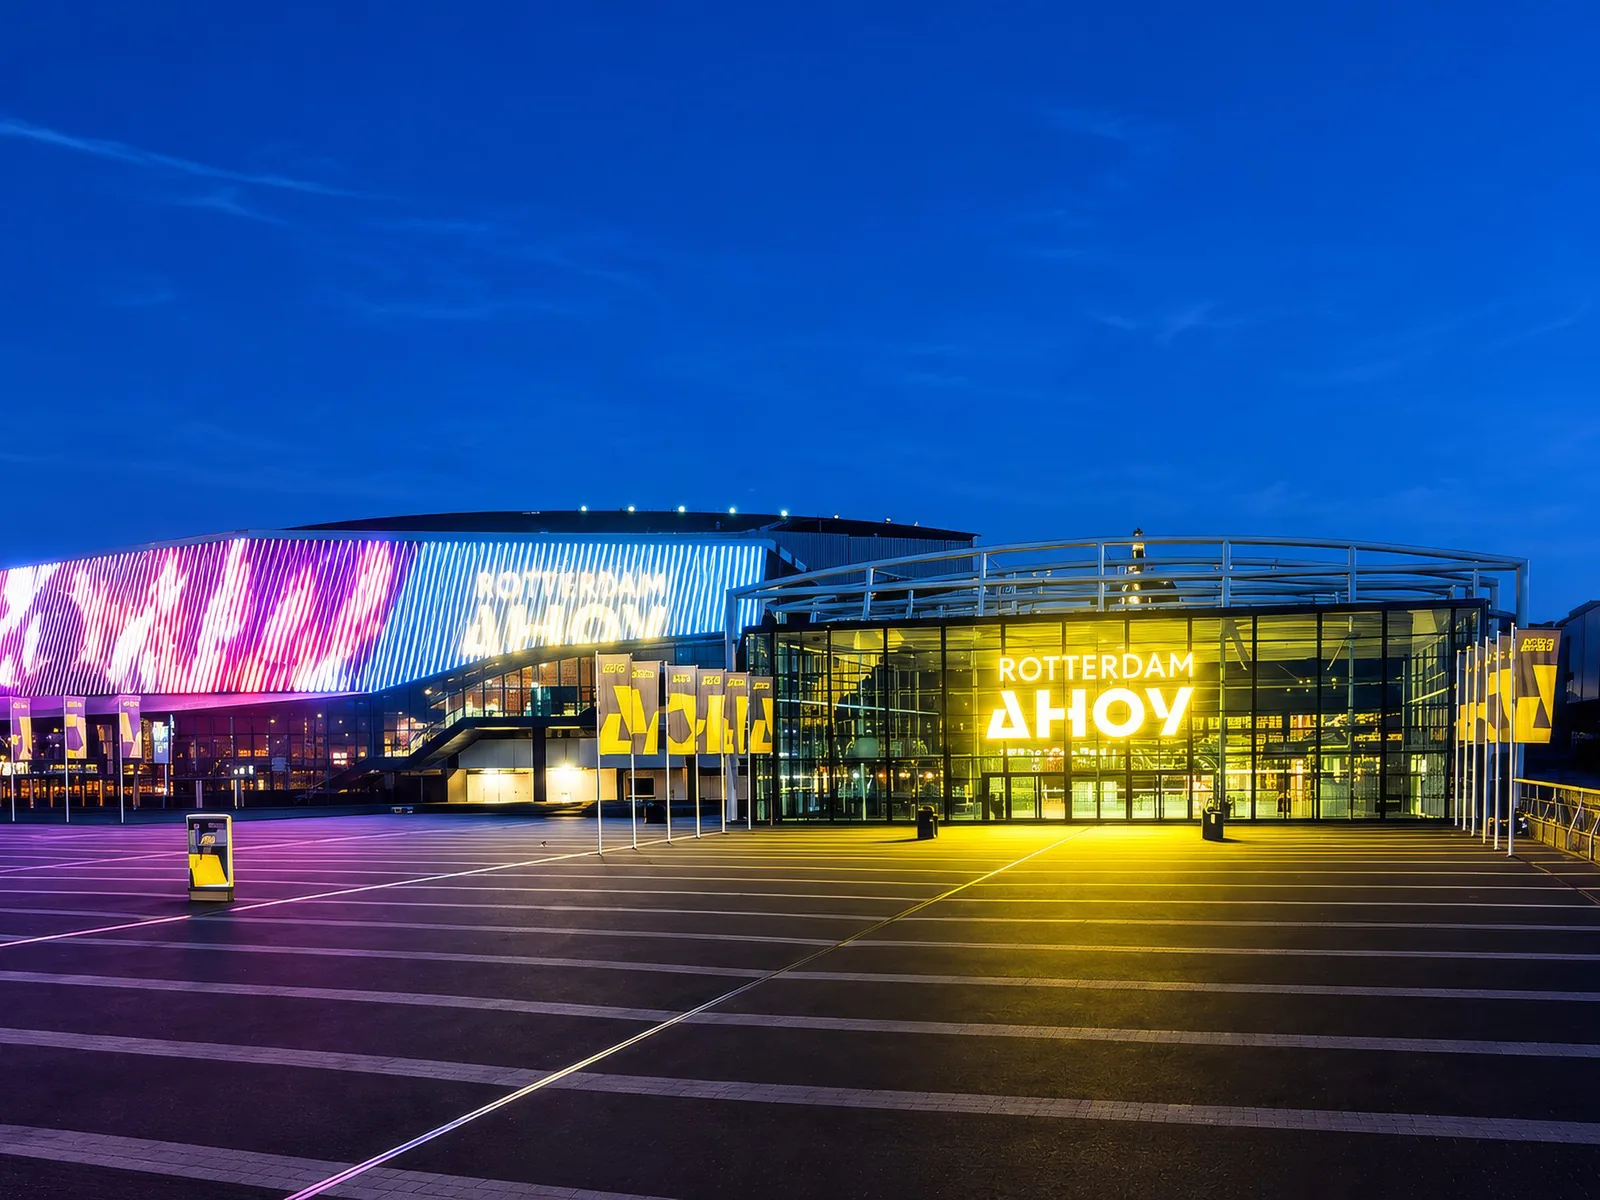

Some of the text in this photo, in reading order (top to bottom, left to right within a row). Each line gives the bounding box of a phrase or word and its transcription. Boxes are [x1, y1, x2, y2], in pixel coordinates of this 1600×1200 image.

[477, 571, 667, 599] ROTTERDAM
[462, 603, 668, 656] AHOY
[999, 652, 1194, 682] ROTTERDAM
[986, 686, 1195, 739] AHOY
